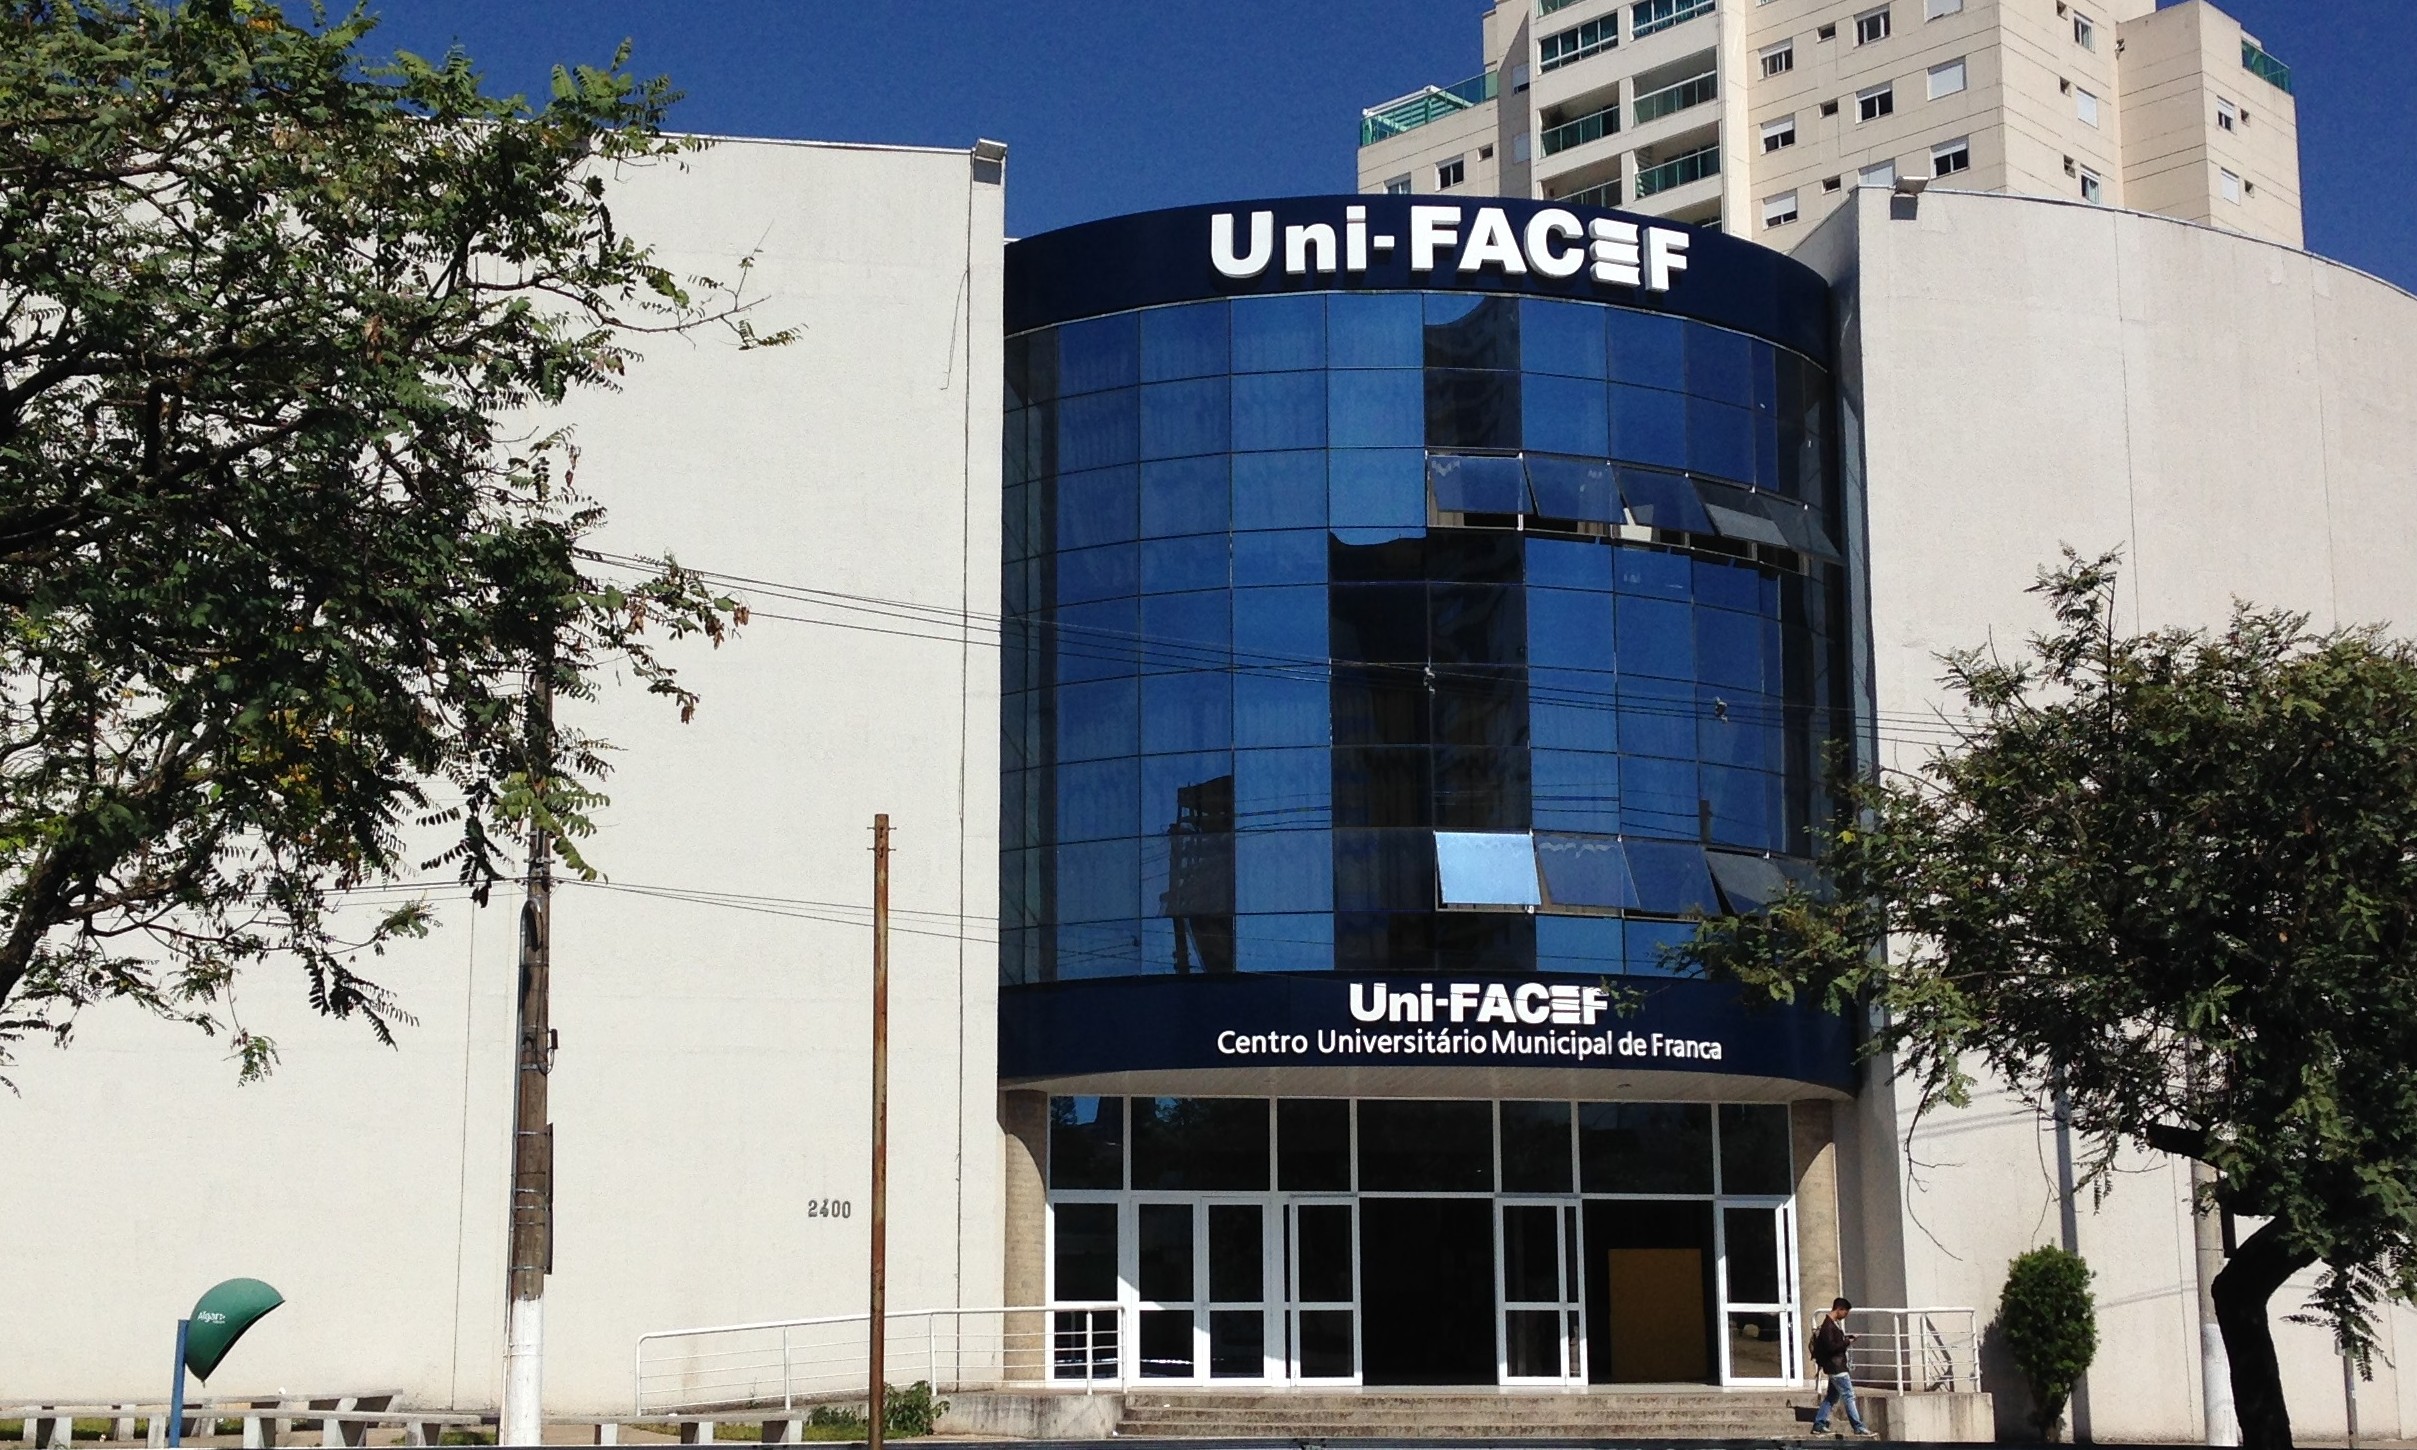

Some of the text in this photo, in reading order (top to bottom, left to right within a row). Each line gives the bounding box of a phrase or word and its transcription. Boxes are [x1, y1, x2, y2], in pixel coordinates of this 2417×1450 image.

[1210, 204, 1689, 292] Uni-FACEF
[1349, 982, 1609, 1025] Uni-FACEF
[1217, 1028, 1722, 1060] Centro Universitário Municipal de Franca
[808, 1199, 851, 1218] 2400
[197, 1310, 219, 1323] Algar
